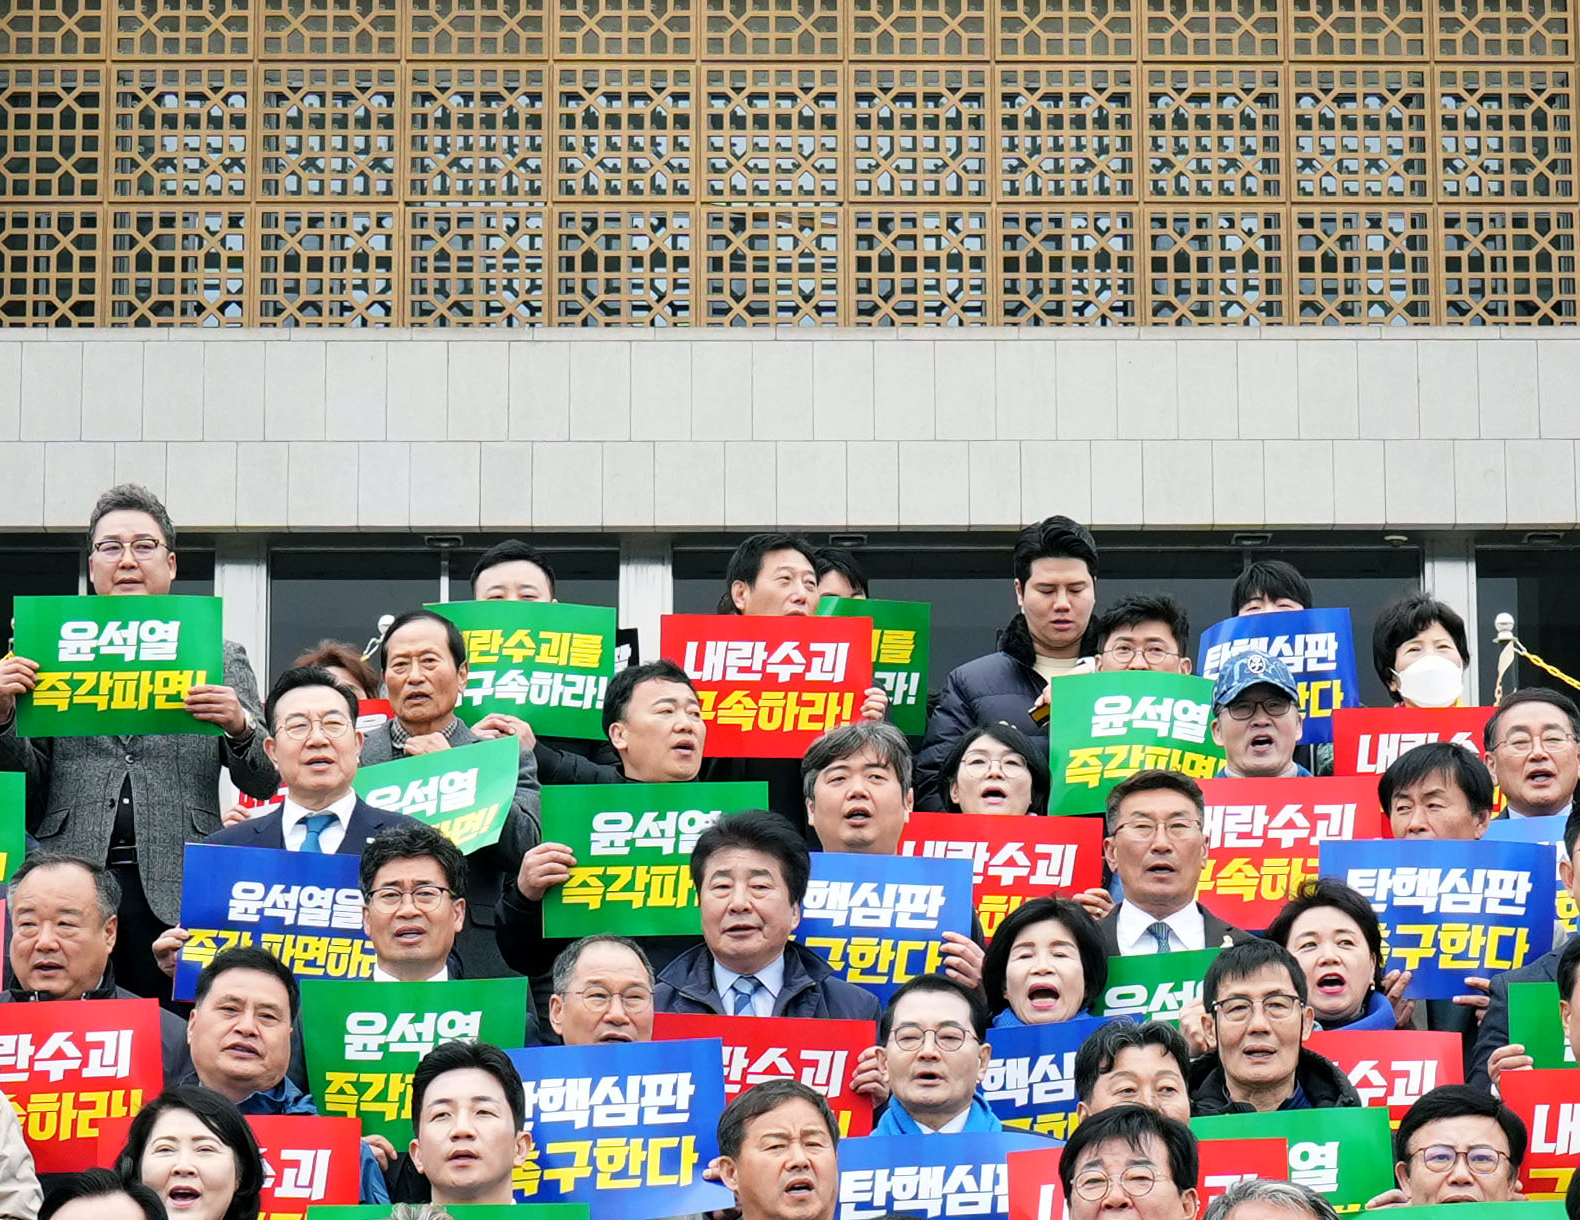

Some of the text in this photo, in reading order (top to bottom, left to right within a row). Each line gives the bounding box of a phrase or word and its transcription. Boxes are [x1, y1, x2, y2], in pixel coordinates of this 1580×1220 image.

[58, 618, 181, 663] 윤석열
[462, 627, 604, 670] 란수괴를
[685, 639, 848, 682] 내란수괴
[33, 671, 206, 713] 즉각파면!
[462, 669, 607, 710] 구속하라!
[1091, 695, 1208, 738] 윤석열
[229, 878, 365, 918] 윤석열을
[564, 864, 698, 911] 즉각파
[808, 878, 944, 929] 핵심판
[1347, 863, 1532, 914] 탄핵심판
[823, 937, 942, 988] 구한다
[521, 1073, 694, 1127] 핵심판
[840, 1164, 1011, 1220] 탄핵심
